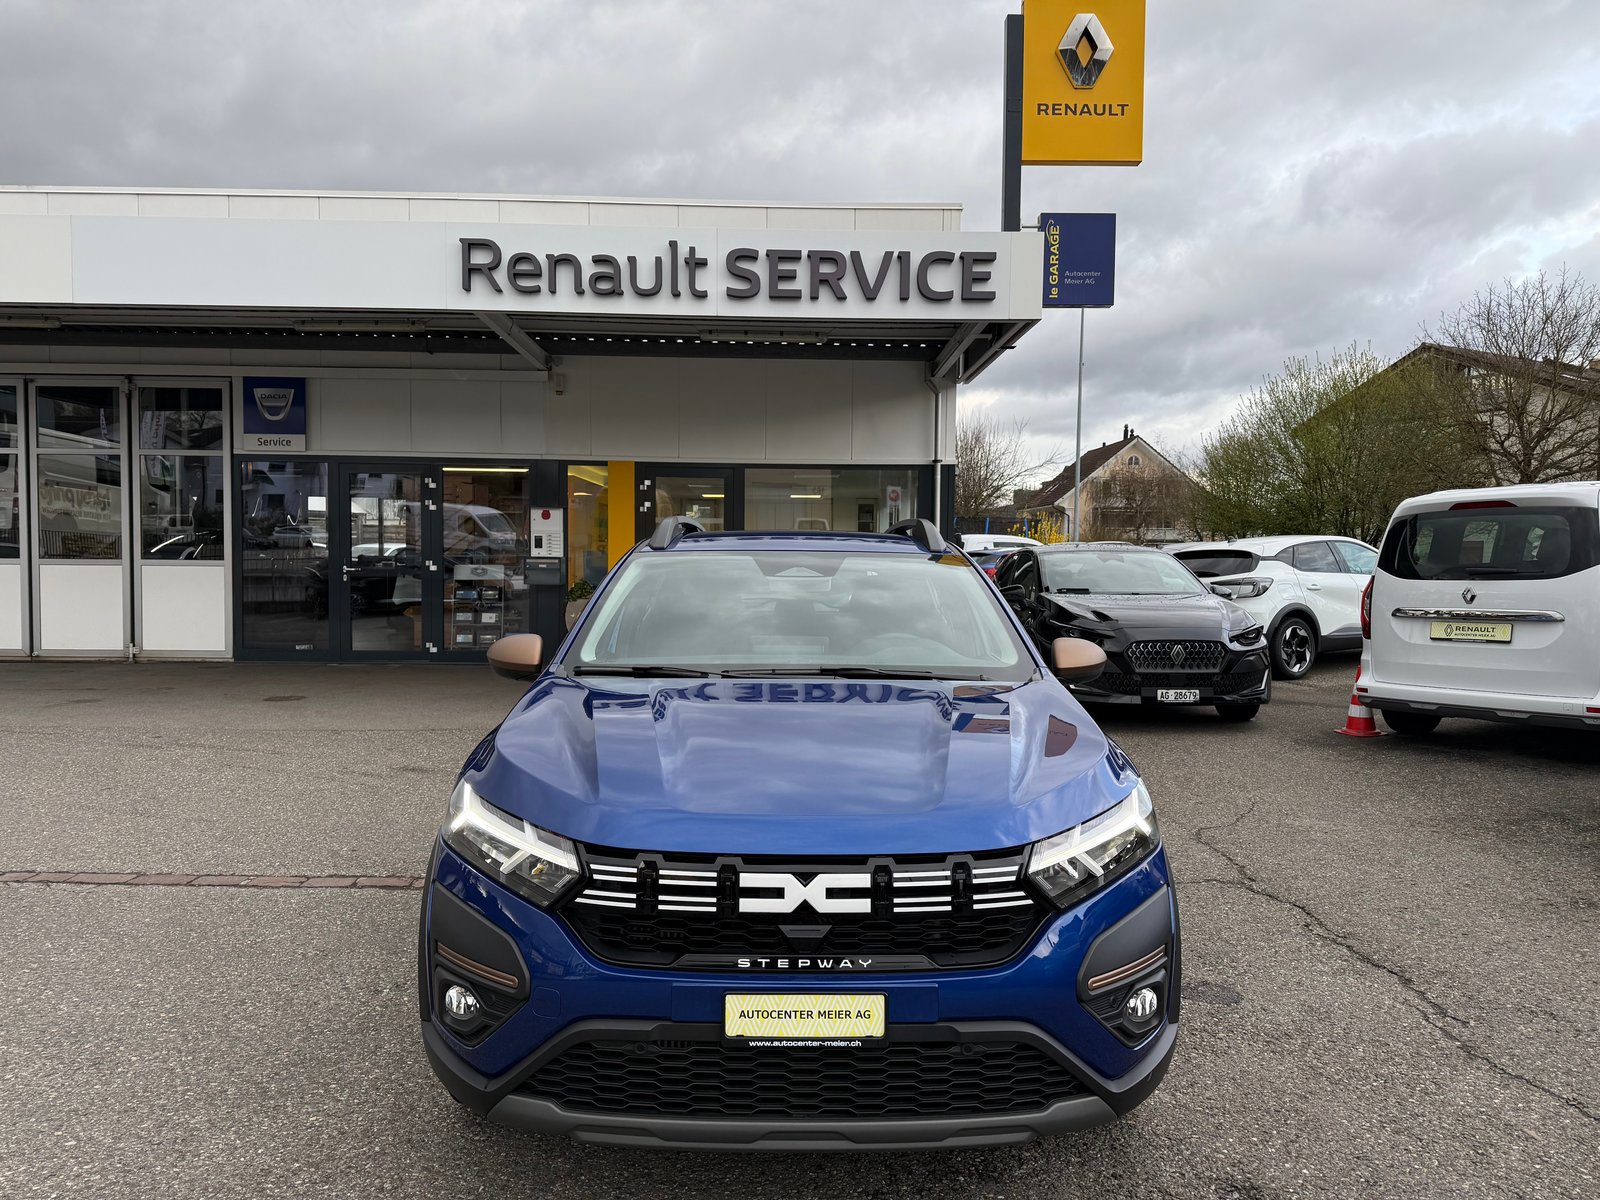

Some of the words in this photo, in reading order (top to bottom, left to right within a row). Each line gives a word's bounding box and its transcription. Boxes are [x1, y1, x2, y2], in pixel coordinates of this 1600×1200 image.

[1037, 103, 1129, 116] RENAULT
[1049, 225, 1060, 285] GARAGE
[459, 238, 708, 298] Renault
[726, 247, 997, 301] SERVICE
[1049, 287, 1058, 298] le
[257, 437, 292, 447] Service
[737, 959, 872, 968] STEPWAY
[738, 1010, 814, 1020] AUTOCENTER
[817, 1010, 852, 1020] MEIER
[855, 1010, 872, 1020] AG
